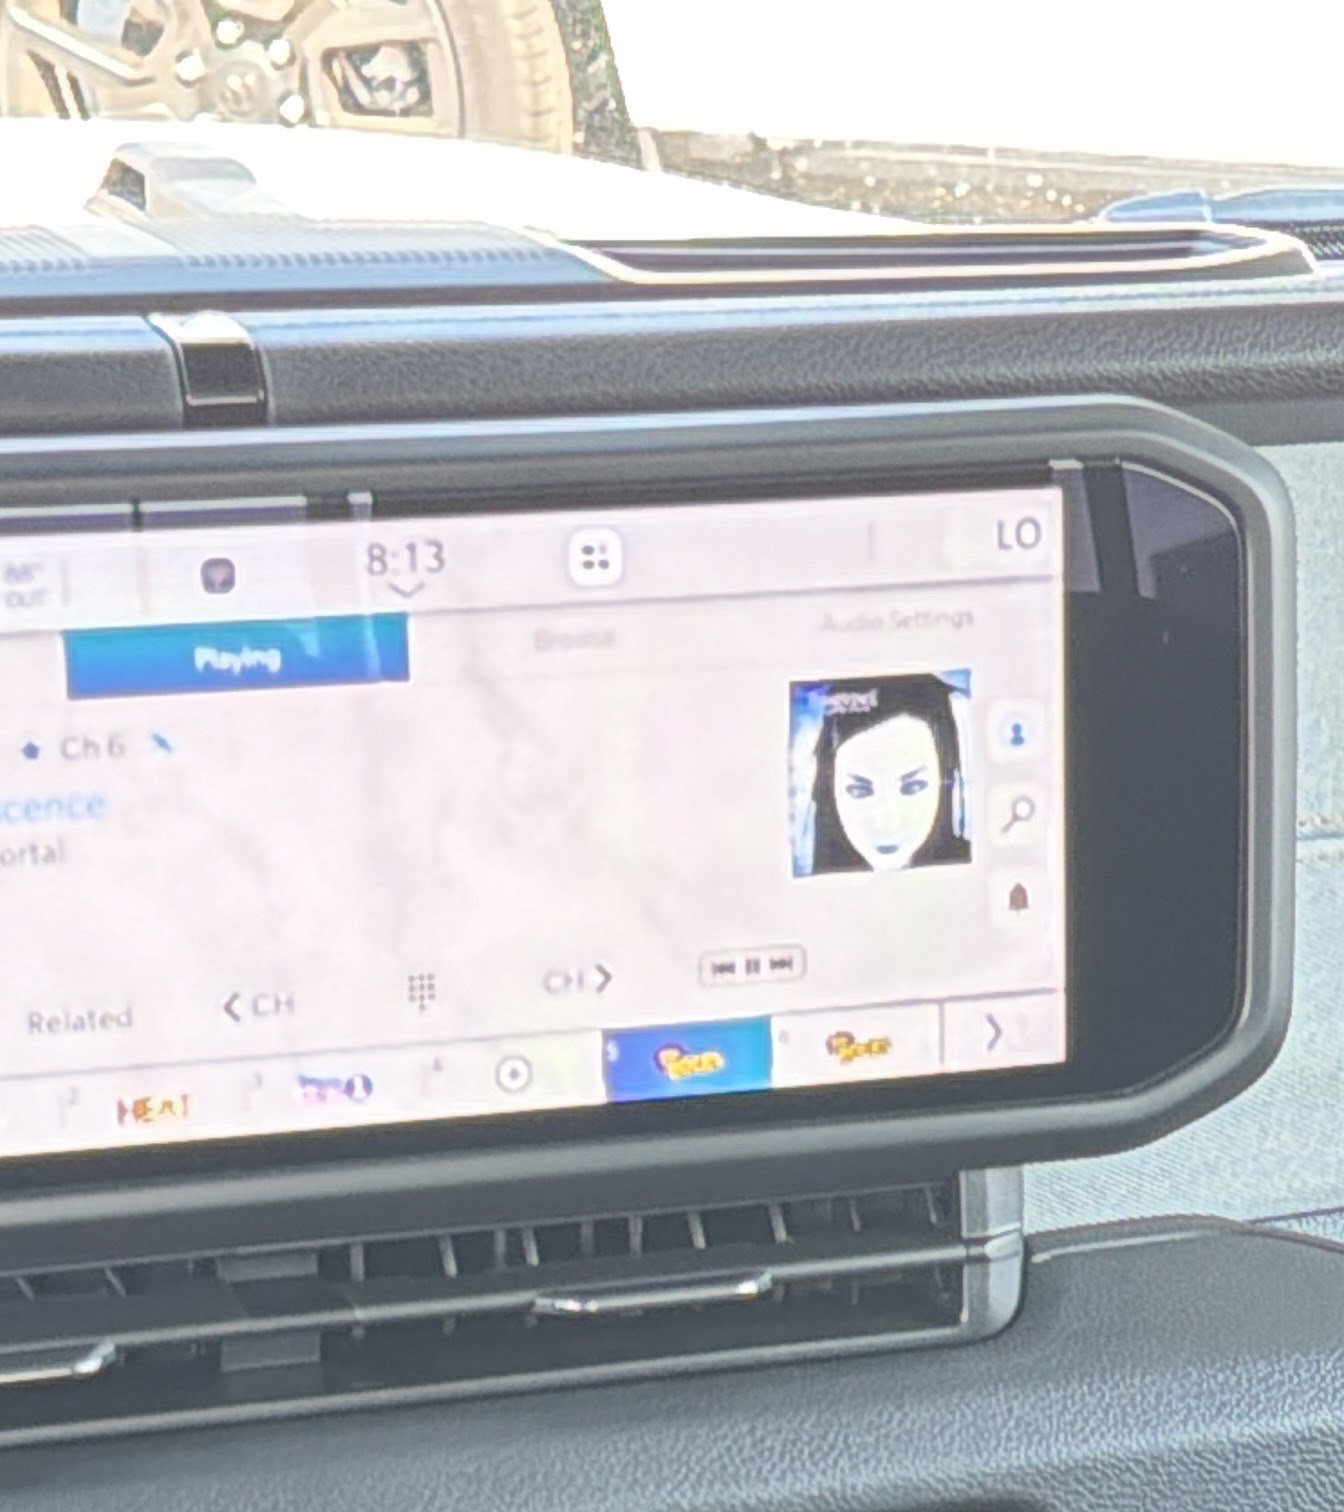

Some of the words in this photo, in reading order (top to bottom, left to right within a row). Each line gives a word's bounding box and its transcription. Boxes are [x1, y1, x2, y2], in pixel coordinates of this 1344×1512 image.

[997, 519, 1042, 550] LO
[367, 540, 445, 577] 8:13
[193, 644, 283, 675] Playing
[60, 735, 101, 761] Ch
[27, 1005, 135, 1035] Related
